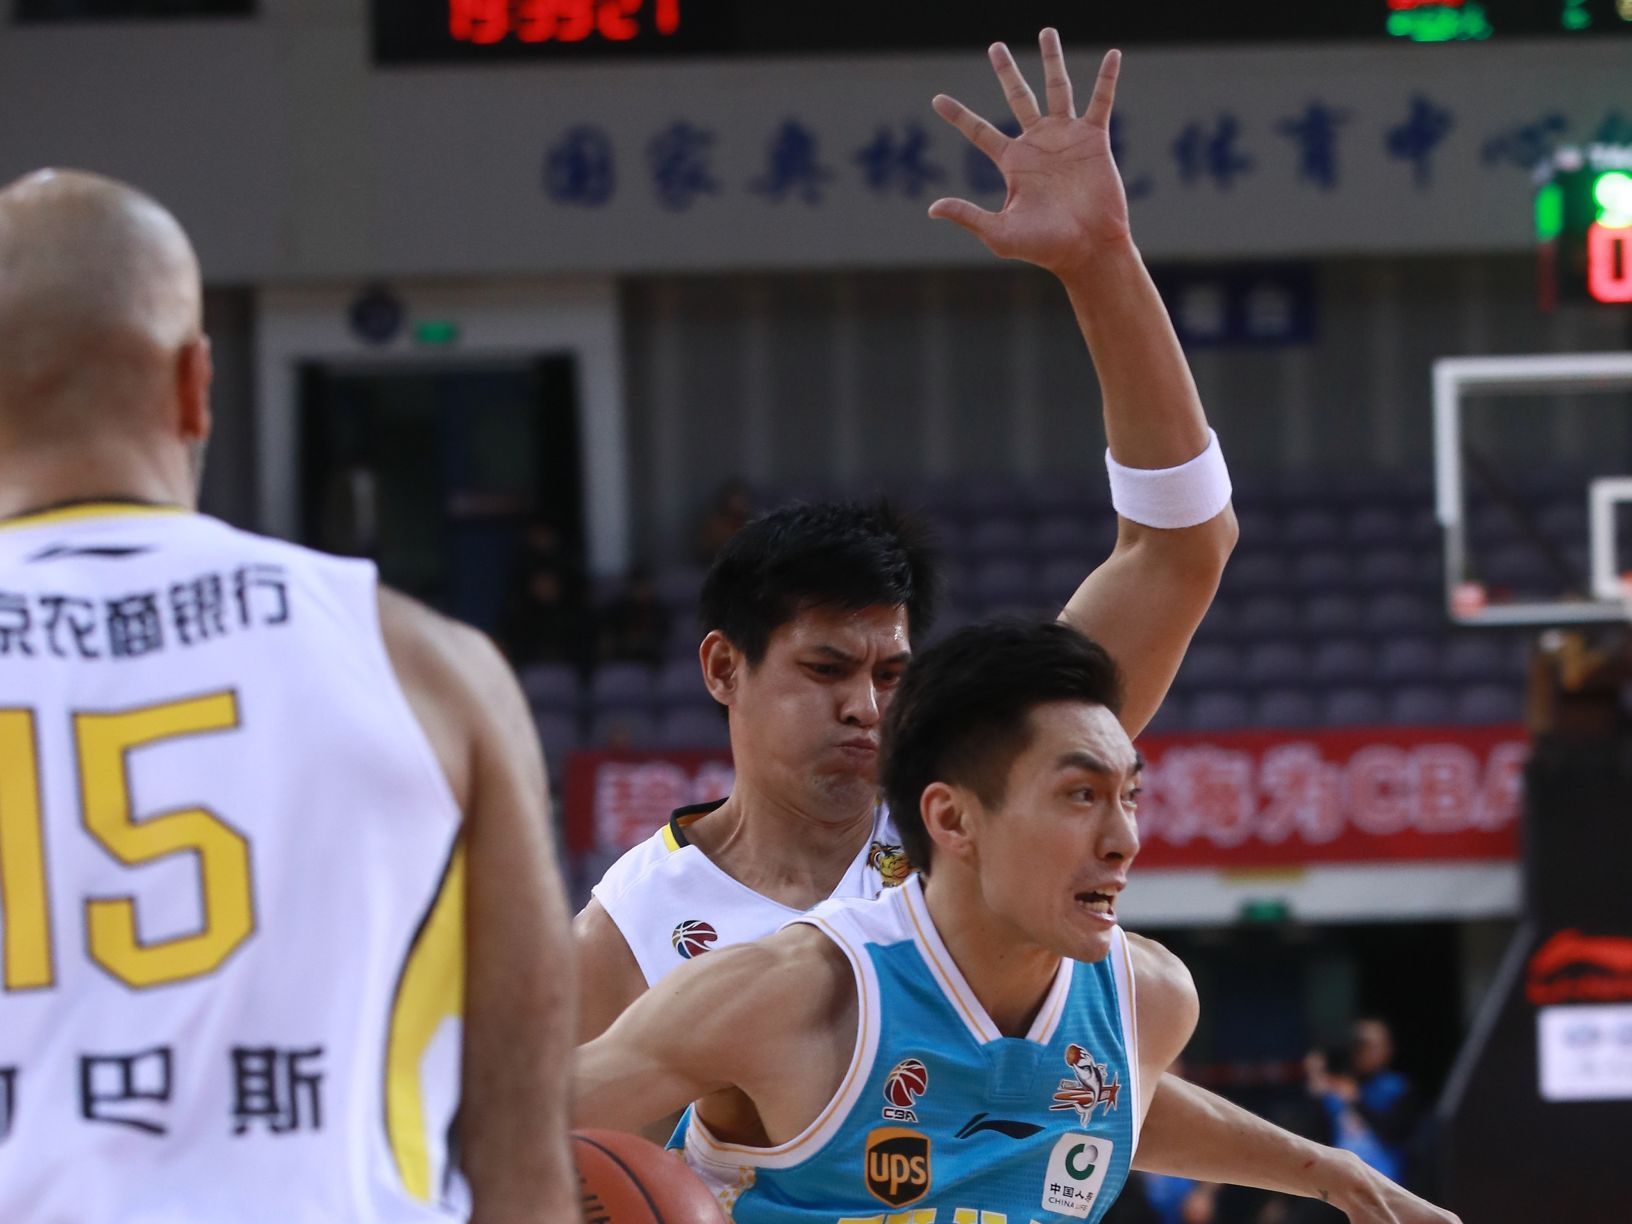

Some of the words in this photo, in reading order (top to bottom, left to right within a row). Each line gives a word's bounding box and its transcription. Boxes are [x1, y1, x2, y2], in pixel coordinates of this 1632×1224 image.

[0, 689, 257, 992] 15
[882, 1107, 918, 1123] CBA
[870, 1151, 927, 1196] ups
